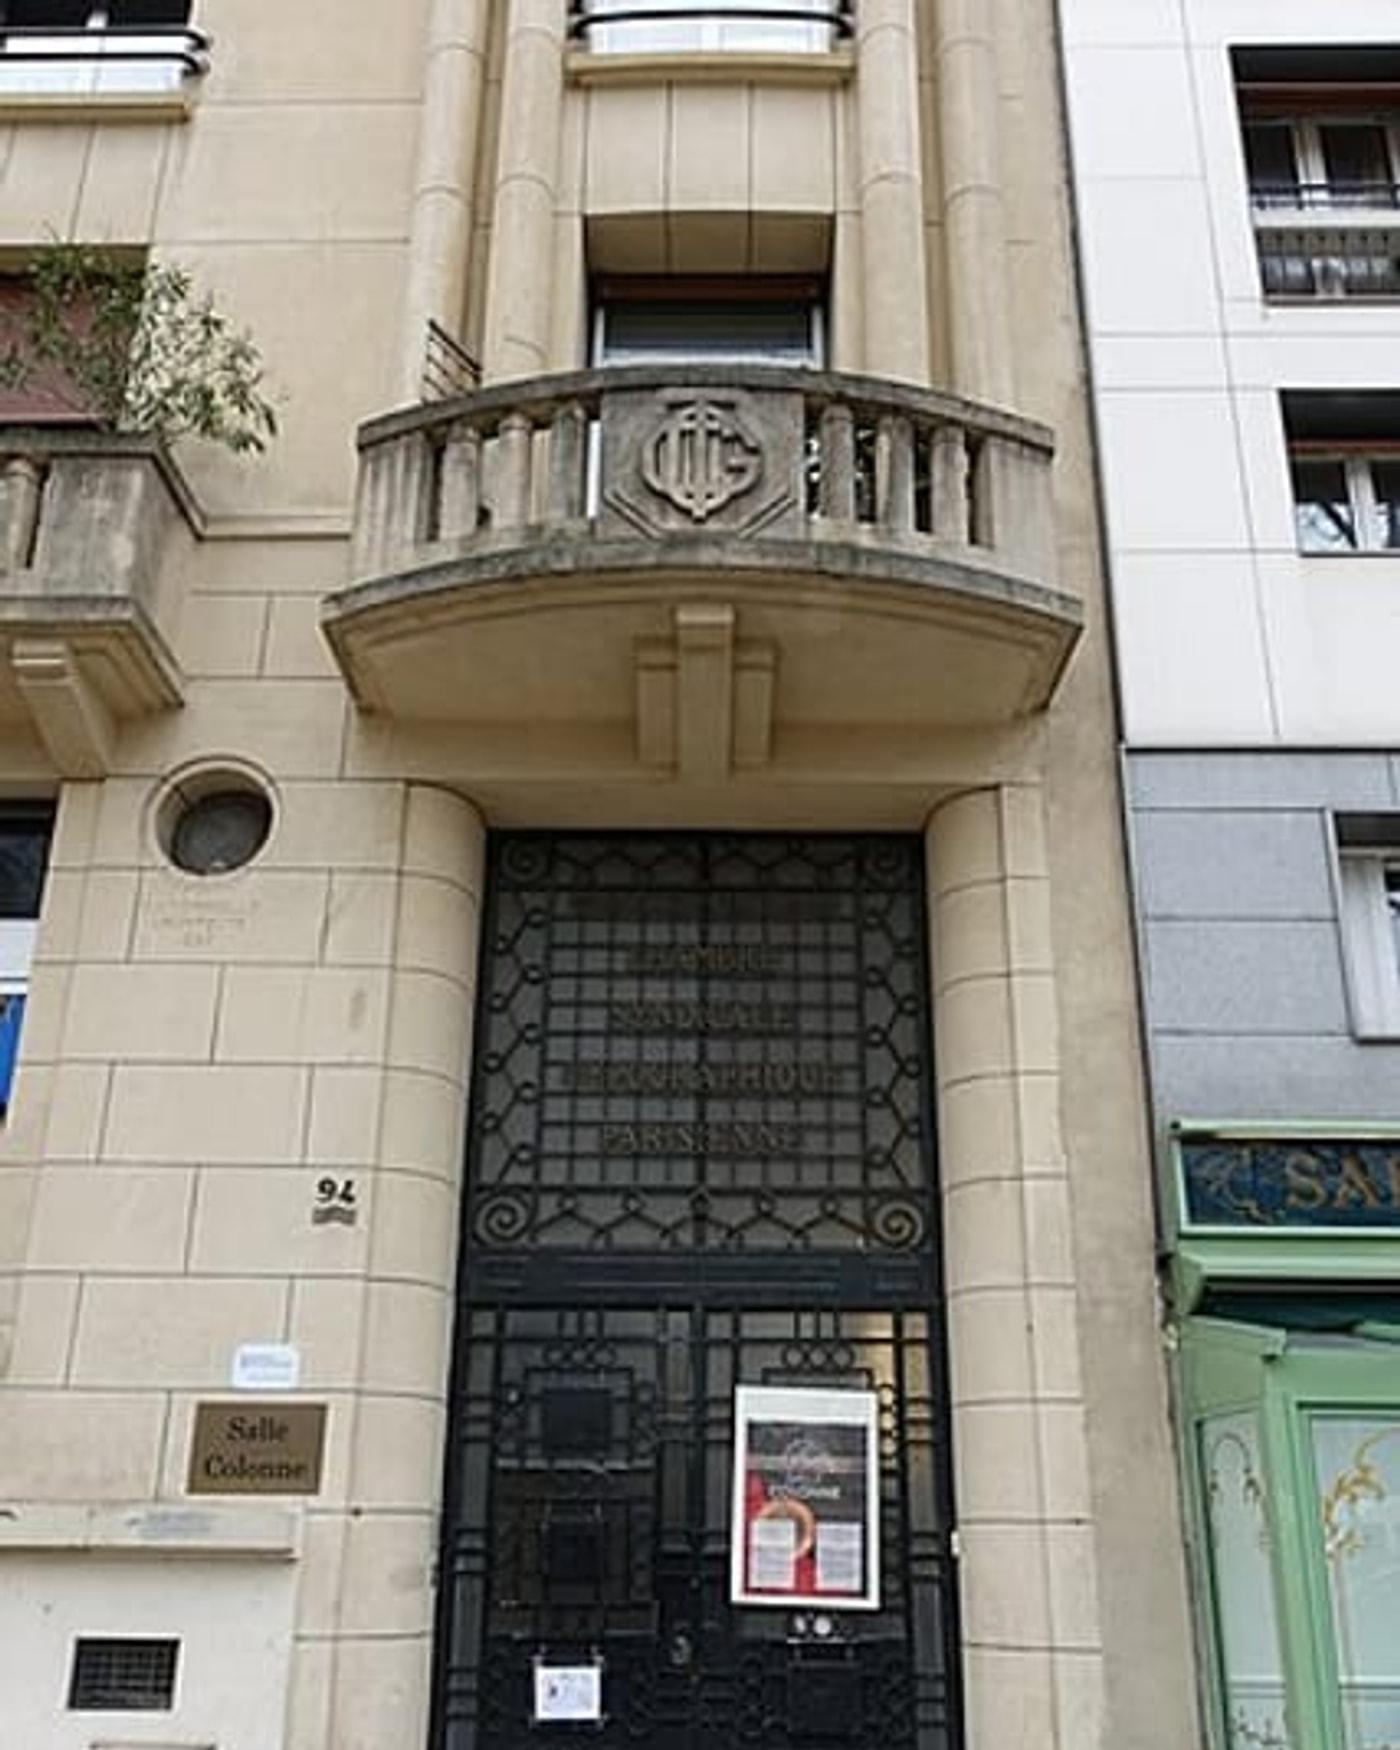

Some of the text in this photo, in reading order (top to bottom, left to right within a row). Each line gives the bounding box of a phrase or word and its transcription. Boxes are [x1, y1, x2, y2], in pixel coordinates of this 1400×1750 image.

[315, 1177, 356, 1204] 94
[226, 1415, 290, 1443] Salle
[204, 1453, 308, 1481] Colonne
